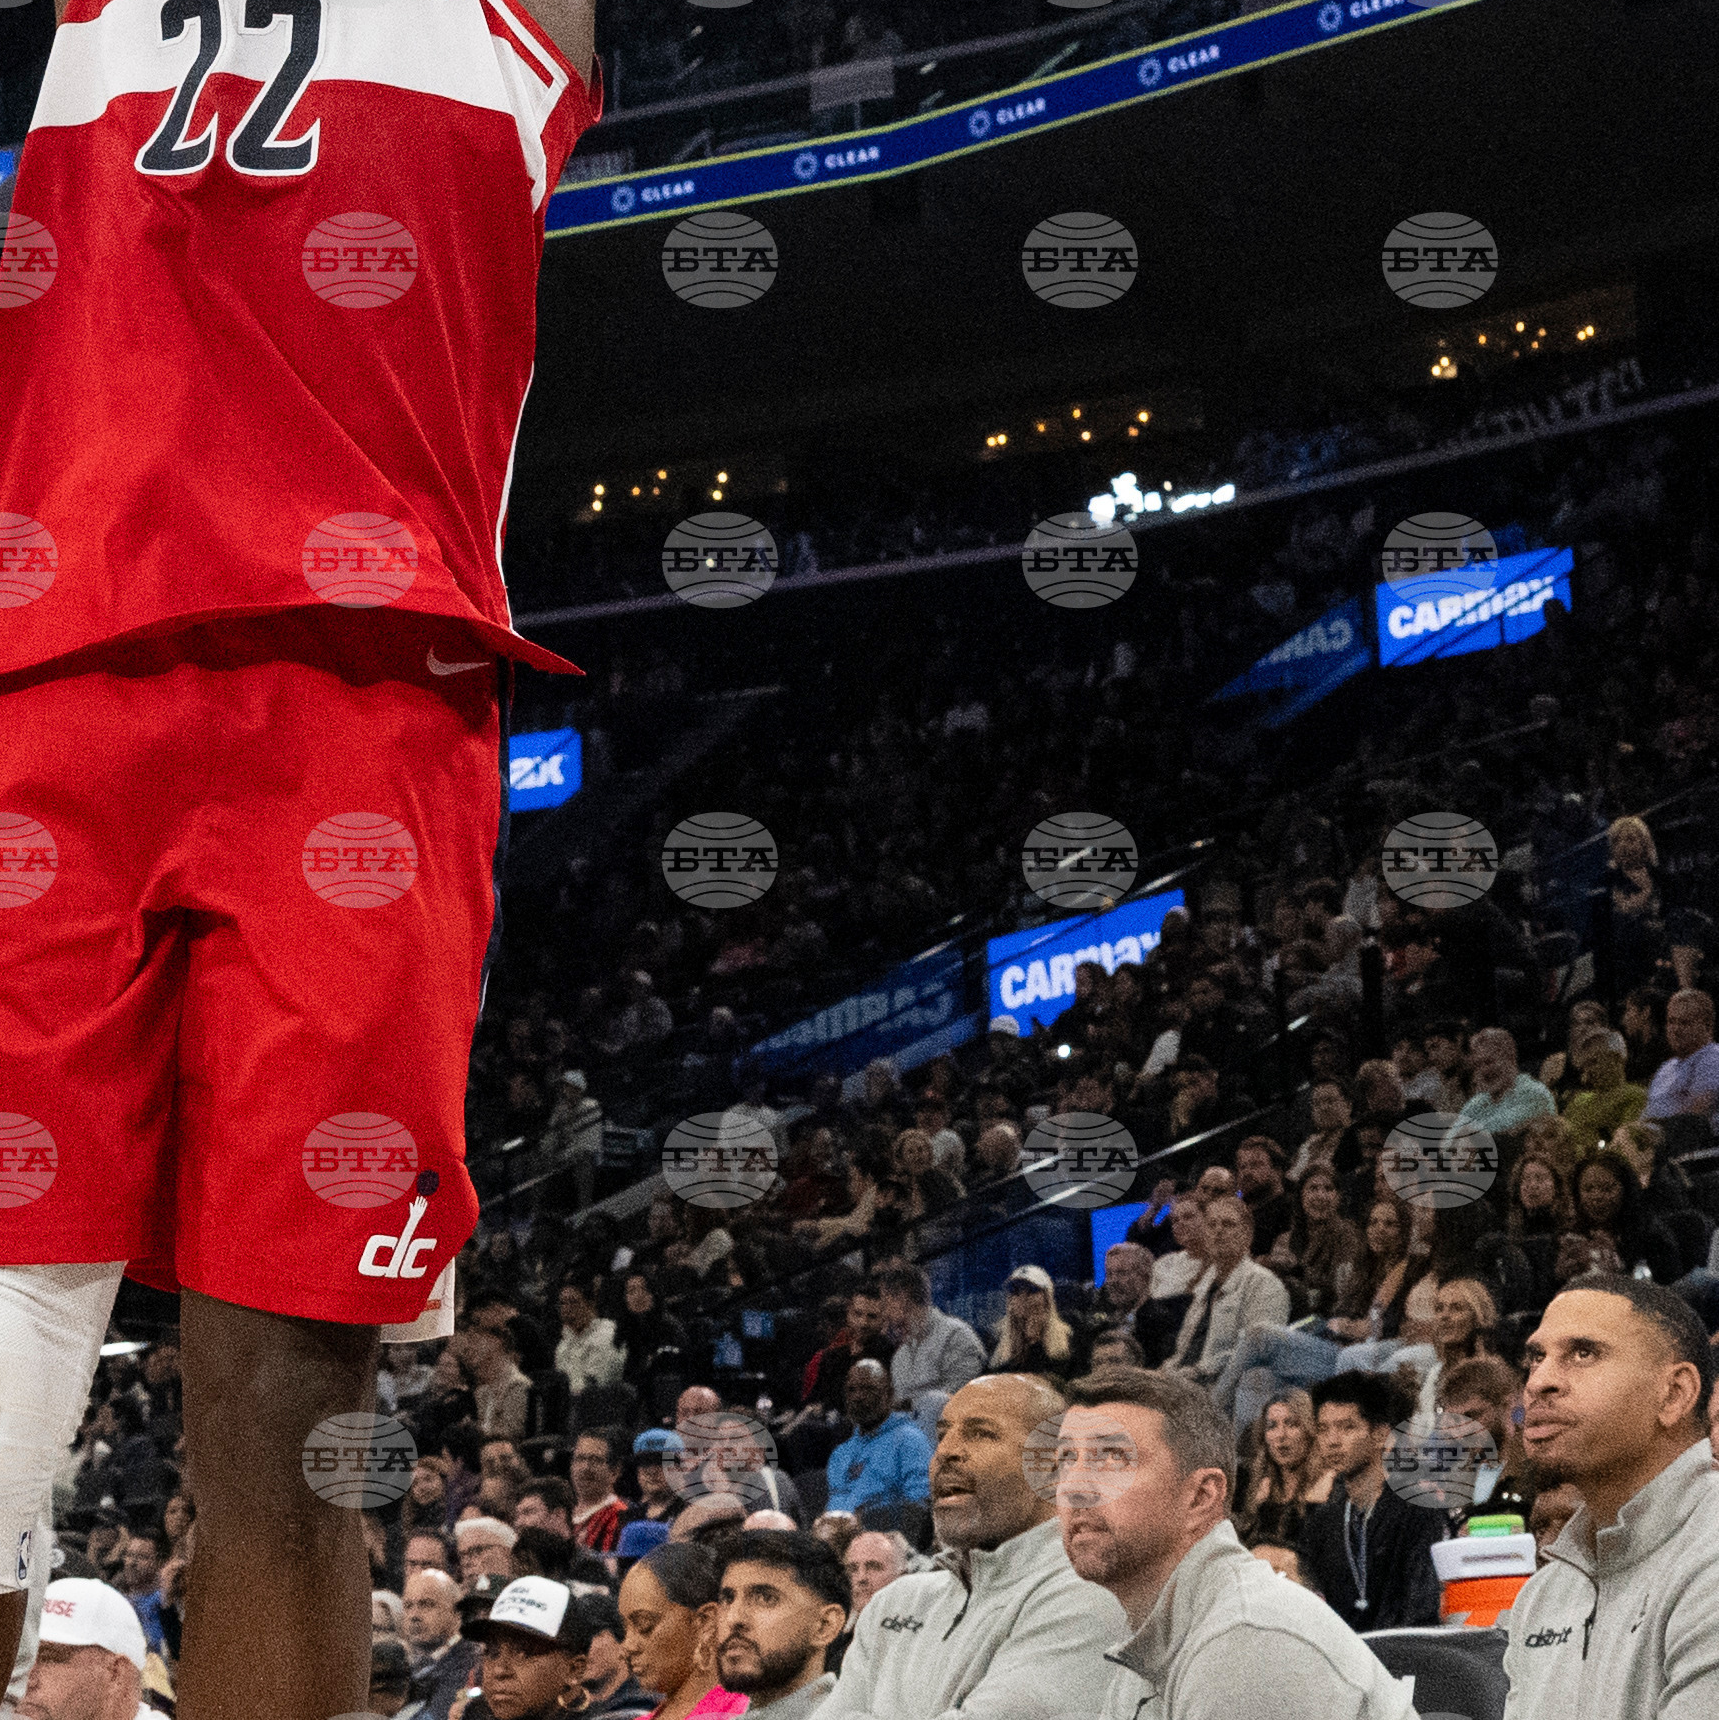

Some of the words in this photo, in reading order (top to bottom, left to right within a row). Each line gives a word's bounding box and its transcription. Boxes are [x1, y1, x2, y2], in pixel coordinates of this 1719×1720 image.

[1168, 44, 1221, 74] CLEAR
[996, 97, 1047, 126] CLEAR
[824, 146, 880, 170] CLEAR
[641, 180, 695, 202] CLEAR
